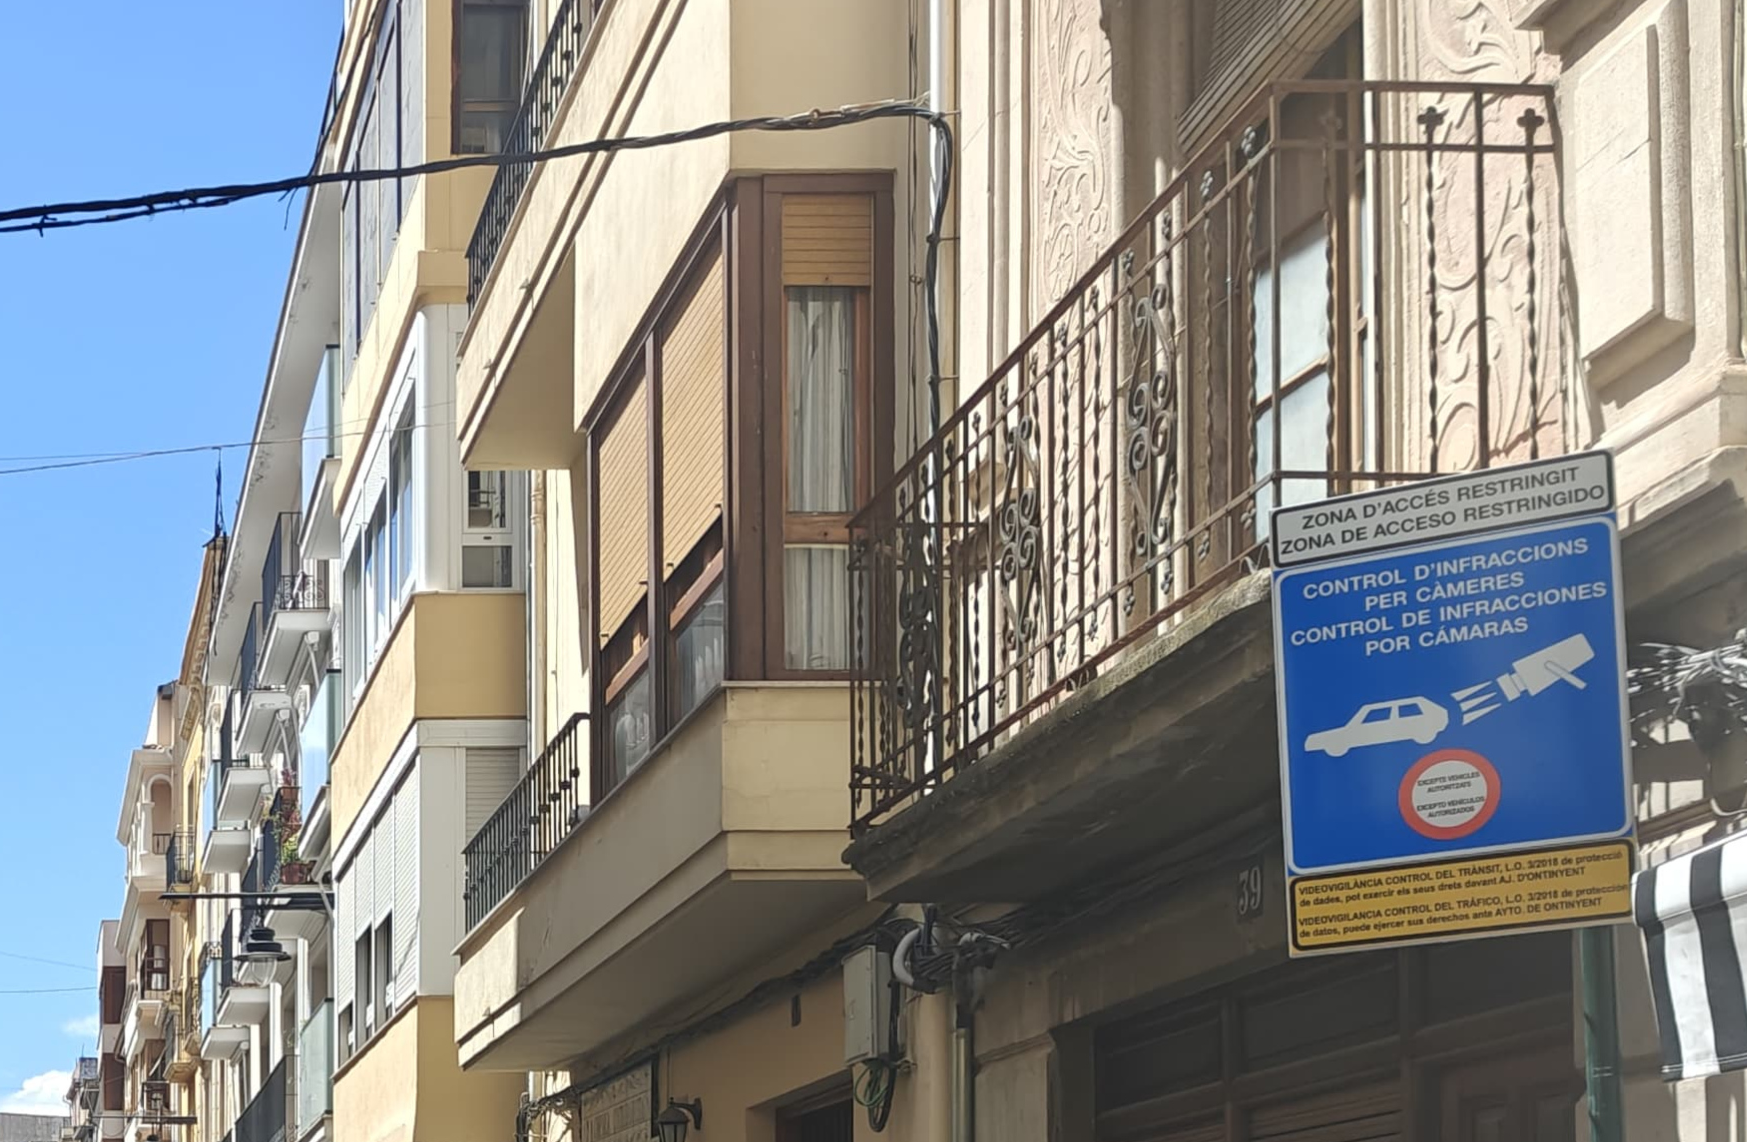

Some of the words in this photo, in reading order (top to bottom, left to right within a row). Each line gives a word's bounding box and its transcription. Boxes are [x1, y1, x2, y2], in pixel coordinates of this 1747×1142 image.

[1302, 508, 1357, 530] ZONA
[1363, 489, 1450, 519] D'ACCÉS
[1457, 466, 1580, 502] RESTRINGIT
[1280, 533, 1336, 555] ZONA
[1341, 527, 1368, 544] DE
[1373, 510, 1456, 538] ACCESO
[1463, 485, 1605, 522] RESTRINGIDO
[1303, 569, 1407, 600] CONTROL
[1414, 537, 1589, 581] D'INFRACCIONS
[1365, 590, 1408, 612] PER
[1416, 571, 1525, 603] CÀMERES
[1290, 616, 1394, 646] CONTROL
[1402, 609, 1431, 628] DE
[1439, 581, 1607, 622] INFRACCIONES
[1366, 635, 1410, 656] POR
[1419, 616, 1529, 647] CÁMARAS
[1237, 864, 1262, 916] 39
[1385, 873, 1433, 885] CONTROL
[1435, 869, 1455, 880] DEL
[1561, 855, 1573, 865] de
[1298, 909, 1383, 927] VIDEOVIGILANCIA
[1384, 904, 1432, 917] CONTROL
[1434, 901, 1454, 912] DEL
[1561, 888, 1573, 898] de
[1299, 898, 1311, 907] de
[1345, 893, 1361, 904] pot
[1363, 888, 1395, 900] exercir
[1396, 885, 1411, 896] els
[1413, 885, 1436, 895] seus
[1438, 881, 1462, 892] drets
[1464, 877, 1497, 889] davant
[1299, 929, 1311, 939] de
[1343, 921, 1371, 934] puede
[1373, 919, 1405, 932] ejercer
[1407, 917, 1424, 927] sus
[1426, 912, 1470, 925] derechos
[1472, 911, 1493, 921] ante
[1527, 902, 1541, 913] DE
[1543, 897, 1603, 912] ONTINYENT
